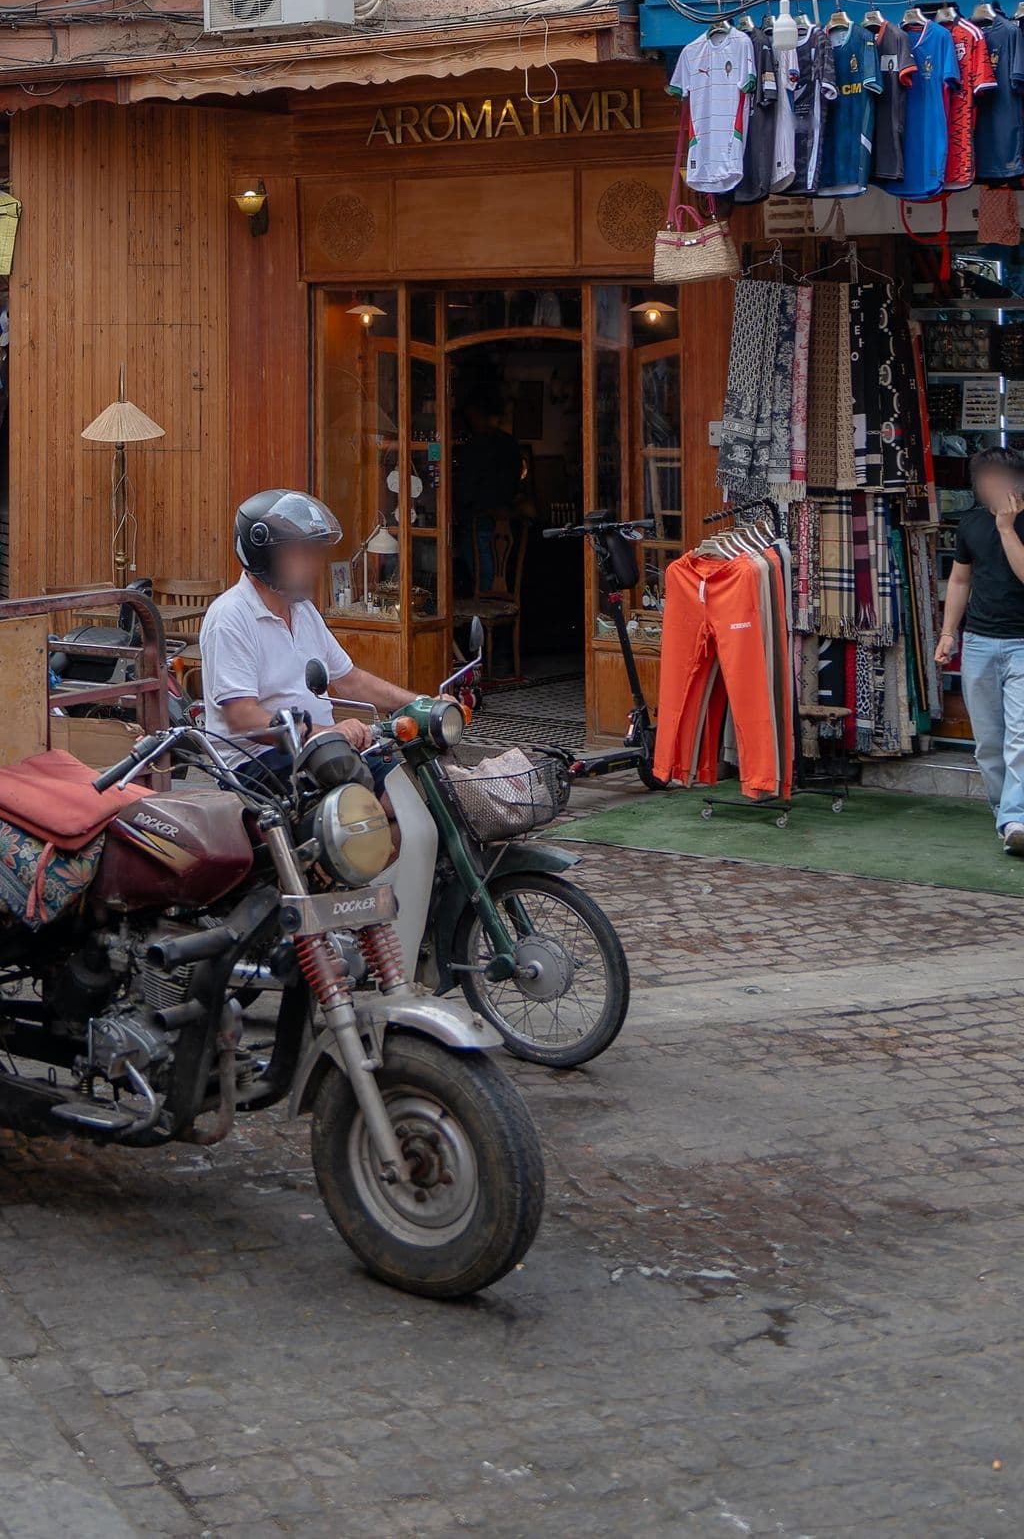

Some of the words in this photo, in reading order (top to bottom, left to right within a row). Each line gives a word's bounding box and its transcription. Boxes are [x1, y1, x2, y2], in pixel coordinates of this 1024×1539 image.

[365, 87, 642, 147] AROMATIMRI
[133, 812, 180, 839] DOCKER
[332, 896, 377, 916] DOCKER
